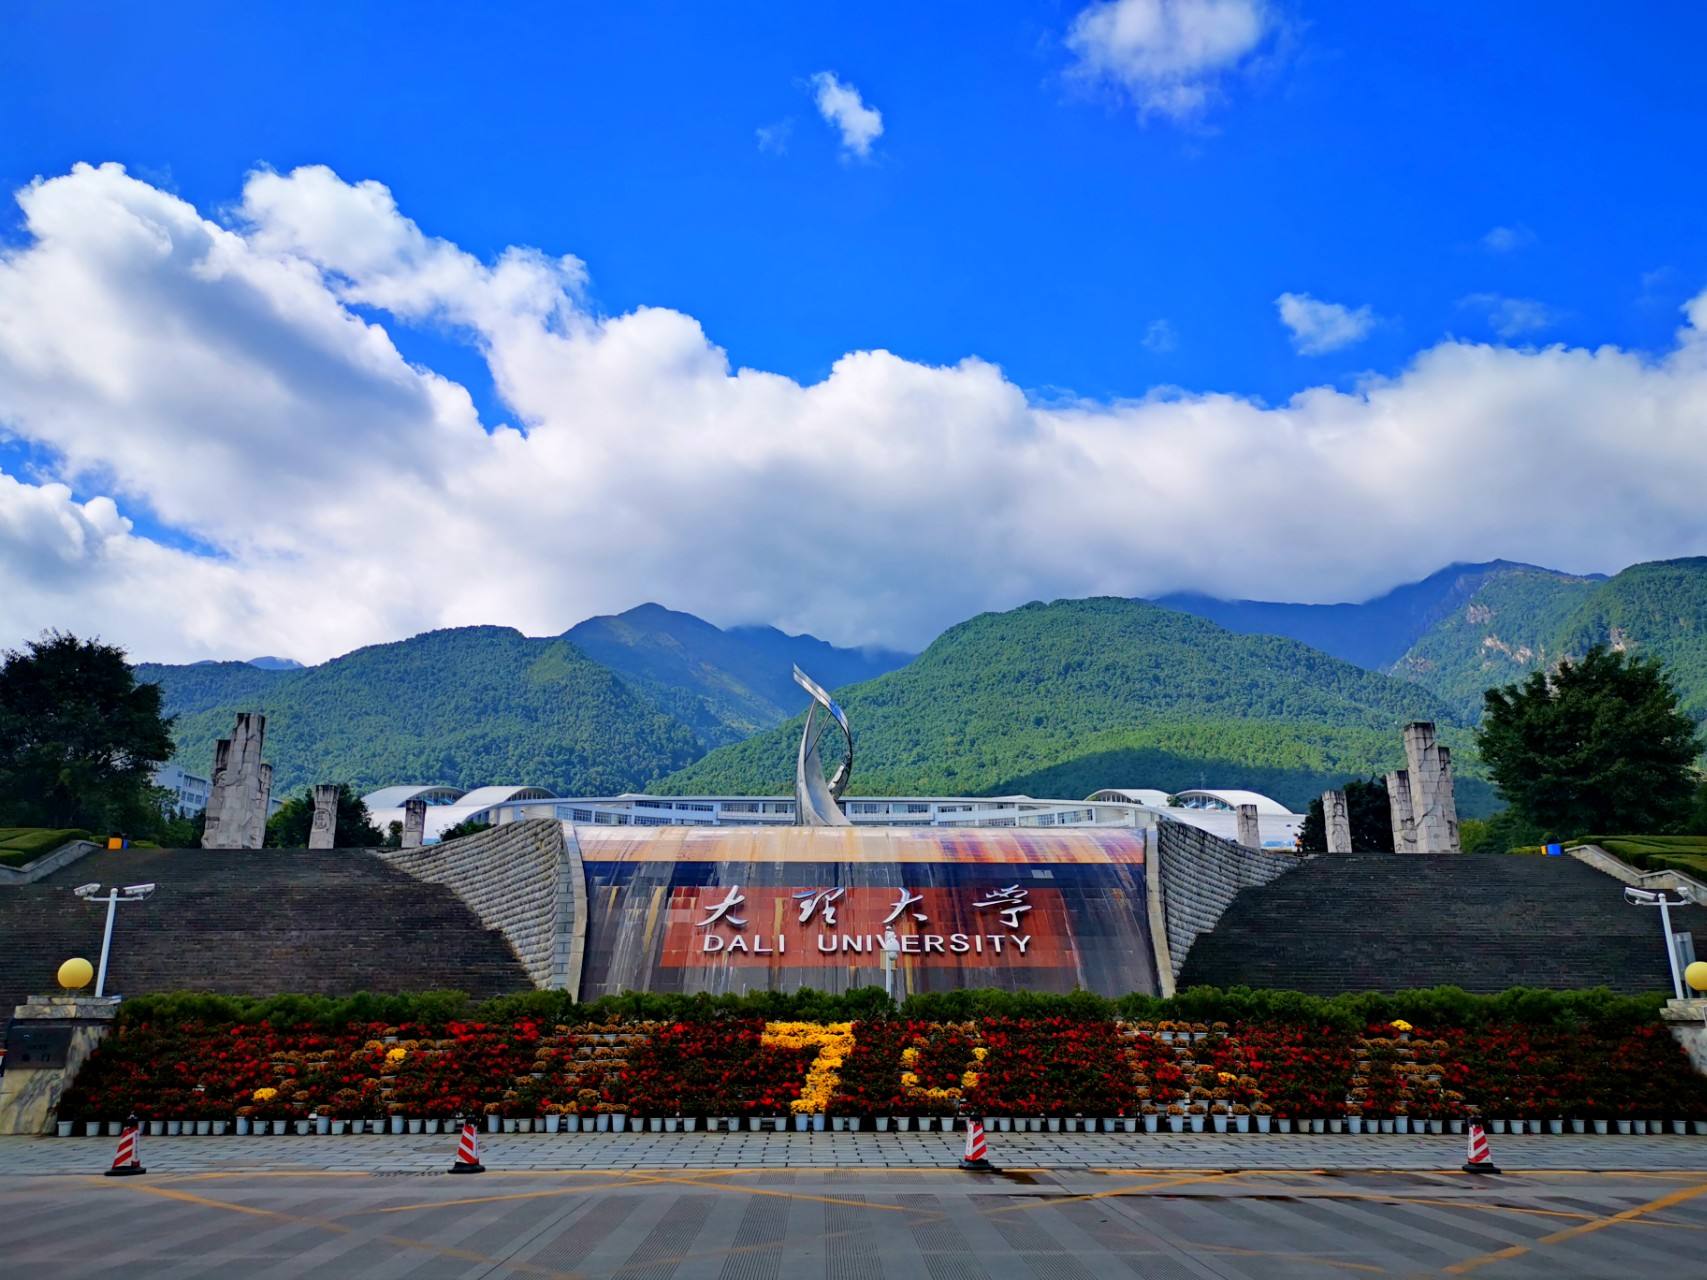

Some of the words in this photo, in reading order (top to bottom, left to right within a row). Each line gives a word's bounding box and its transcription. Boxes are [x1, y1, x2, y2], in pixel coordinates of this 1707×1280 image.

[695, 884, 1032, 928] 大理大学
[703, 934, 785, 953] DALI
